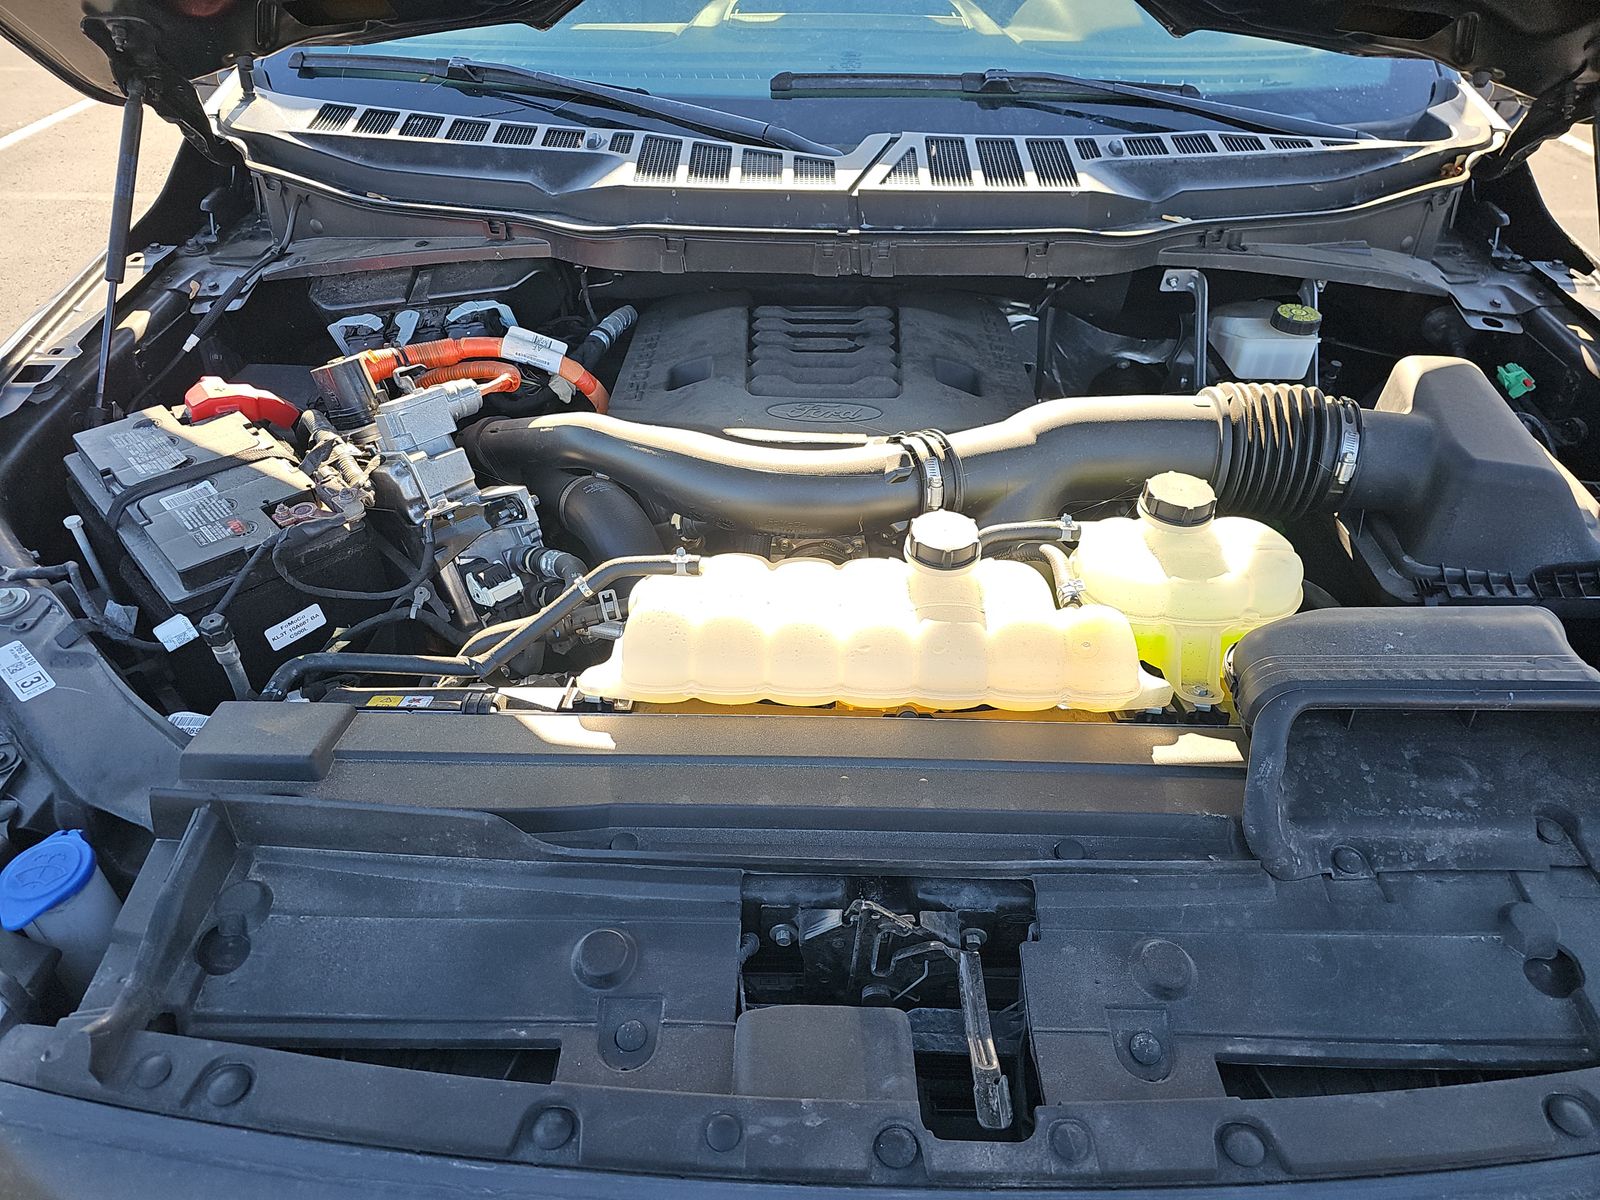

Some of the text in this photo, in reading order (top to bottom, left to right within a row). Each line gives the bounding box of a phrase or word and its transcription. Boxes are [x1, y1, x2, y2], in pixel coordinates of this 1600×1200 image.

[786, 403, 863, 420] Ford
[280, 614, 306, 631] FoMoCo
[271, 630, 288, 642] KL3T
[20, 676, 42, 689] 3
